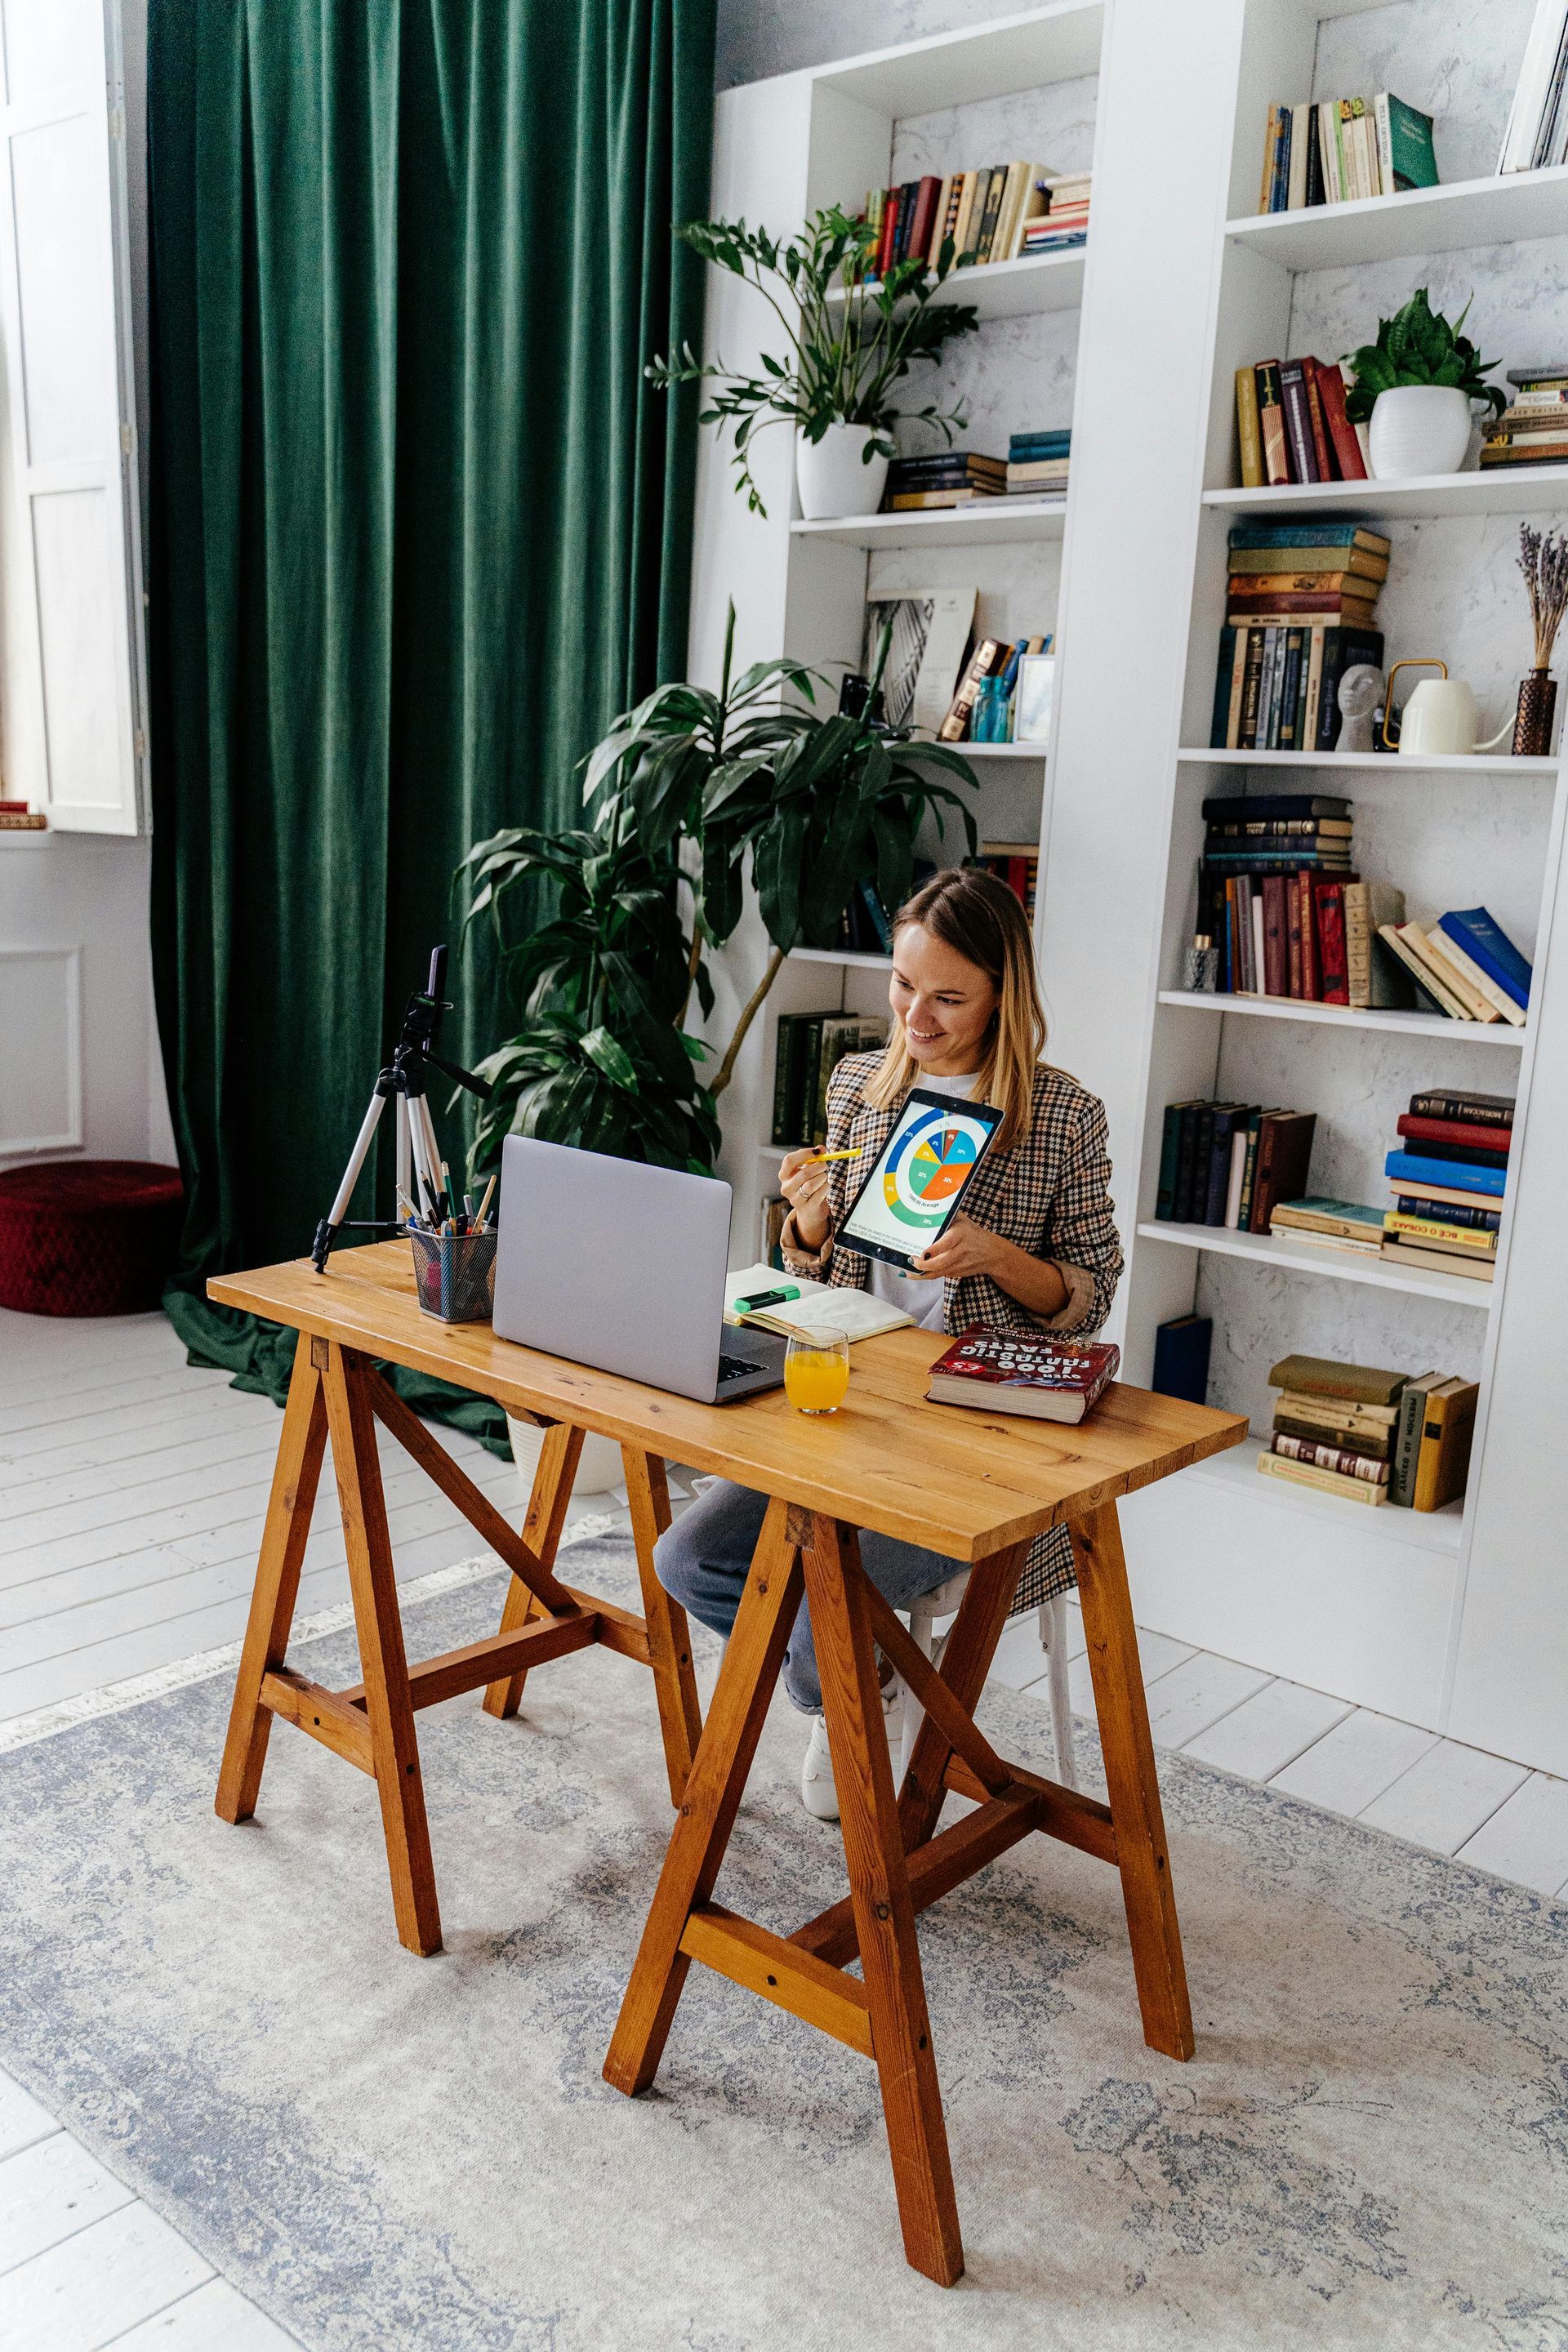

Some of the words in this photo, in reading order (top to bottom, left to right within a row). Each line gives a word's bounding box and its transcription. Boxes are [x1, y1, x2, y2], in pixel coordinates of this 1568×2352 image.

[973, 1340, 1052, 1354] FACTS
[952, 1361, 983, 1370] £5
[998, 1361, 1071, 1374] 1000
